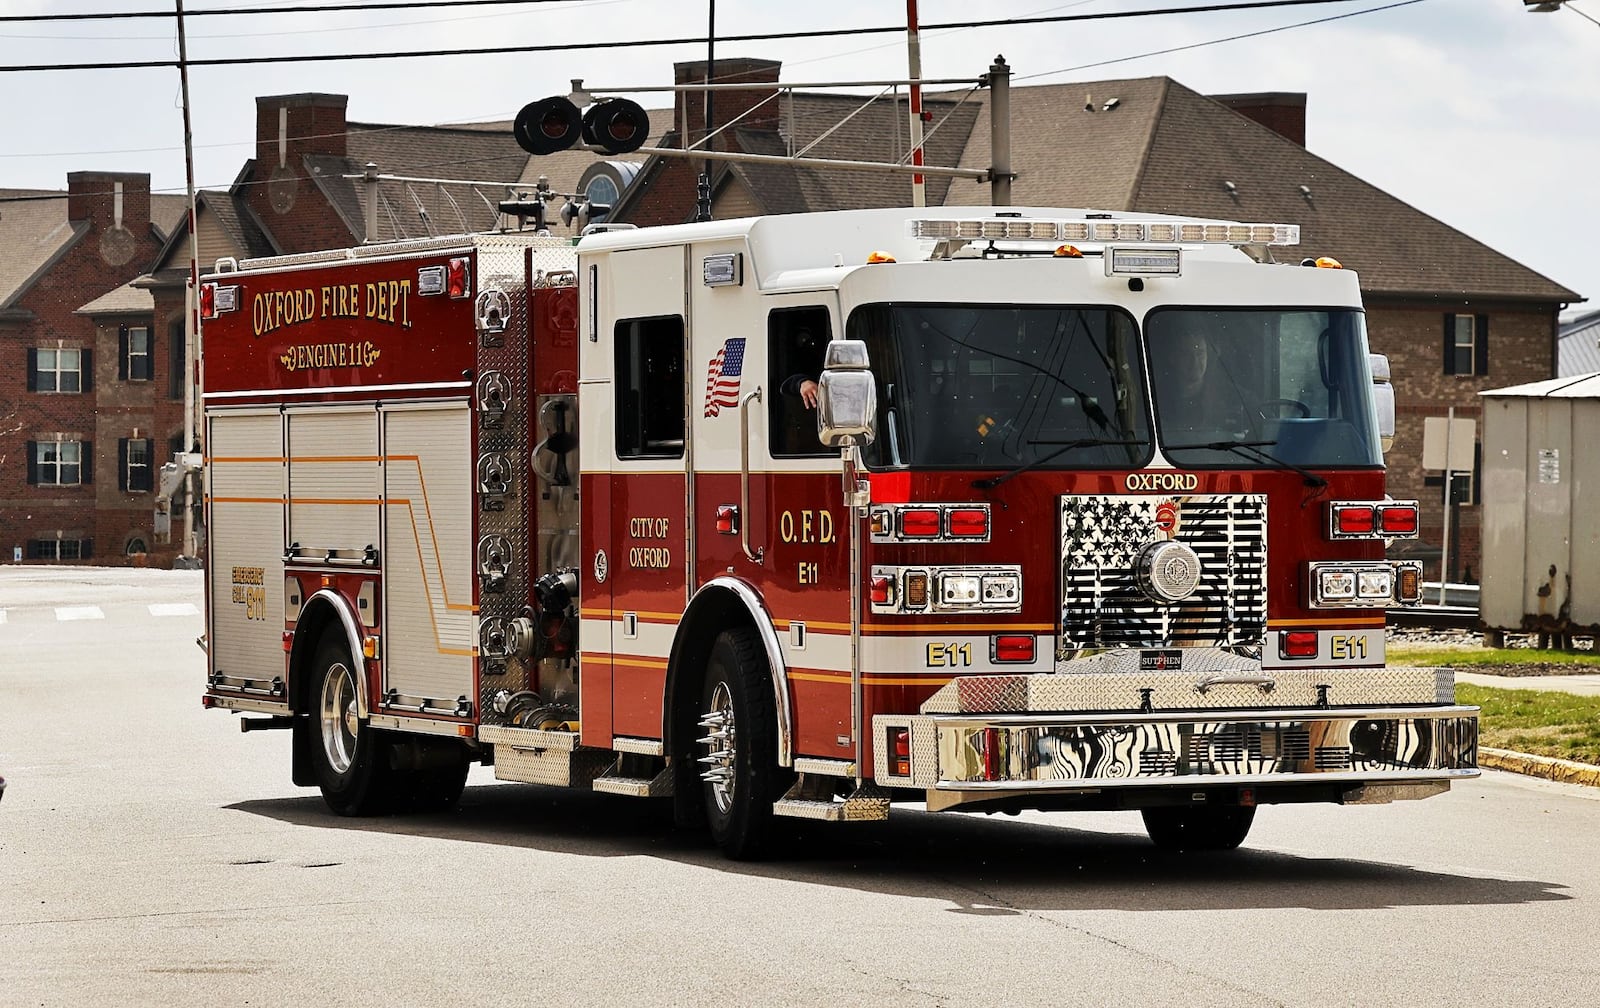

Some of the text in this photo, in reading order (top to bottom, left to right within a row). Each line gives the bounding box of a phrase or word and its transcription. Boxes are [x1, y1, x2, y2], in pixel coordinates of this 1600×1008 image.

[253, 288, 316, 337] OXFORD
[320, 284, 359, 318] FIRE
[297, 341, 363, 369] ENGINE 11
[1125, 473, 1199, 491] OXFORD
[629, 517, 669, 539] CITY OF
[629, 547, 671, 569] OXFORD
[798, 562, 819, 584] E11
[247, 586, 266, 621] 911
[926, 642, 973, 667] E11
[1331, 635, 1368, 659] E11
[1142, 656, 1181, 665] SUTPHEN
